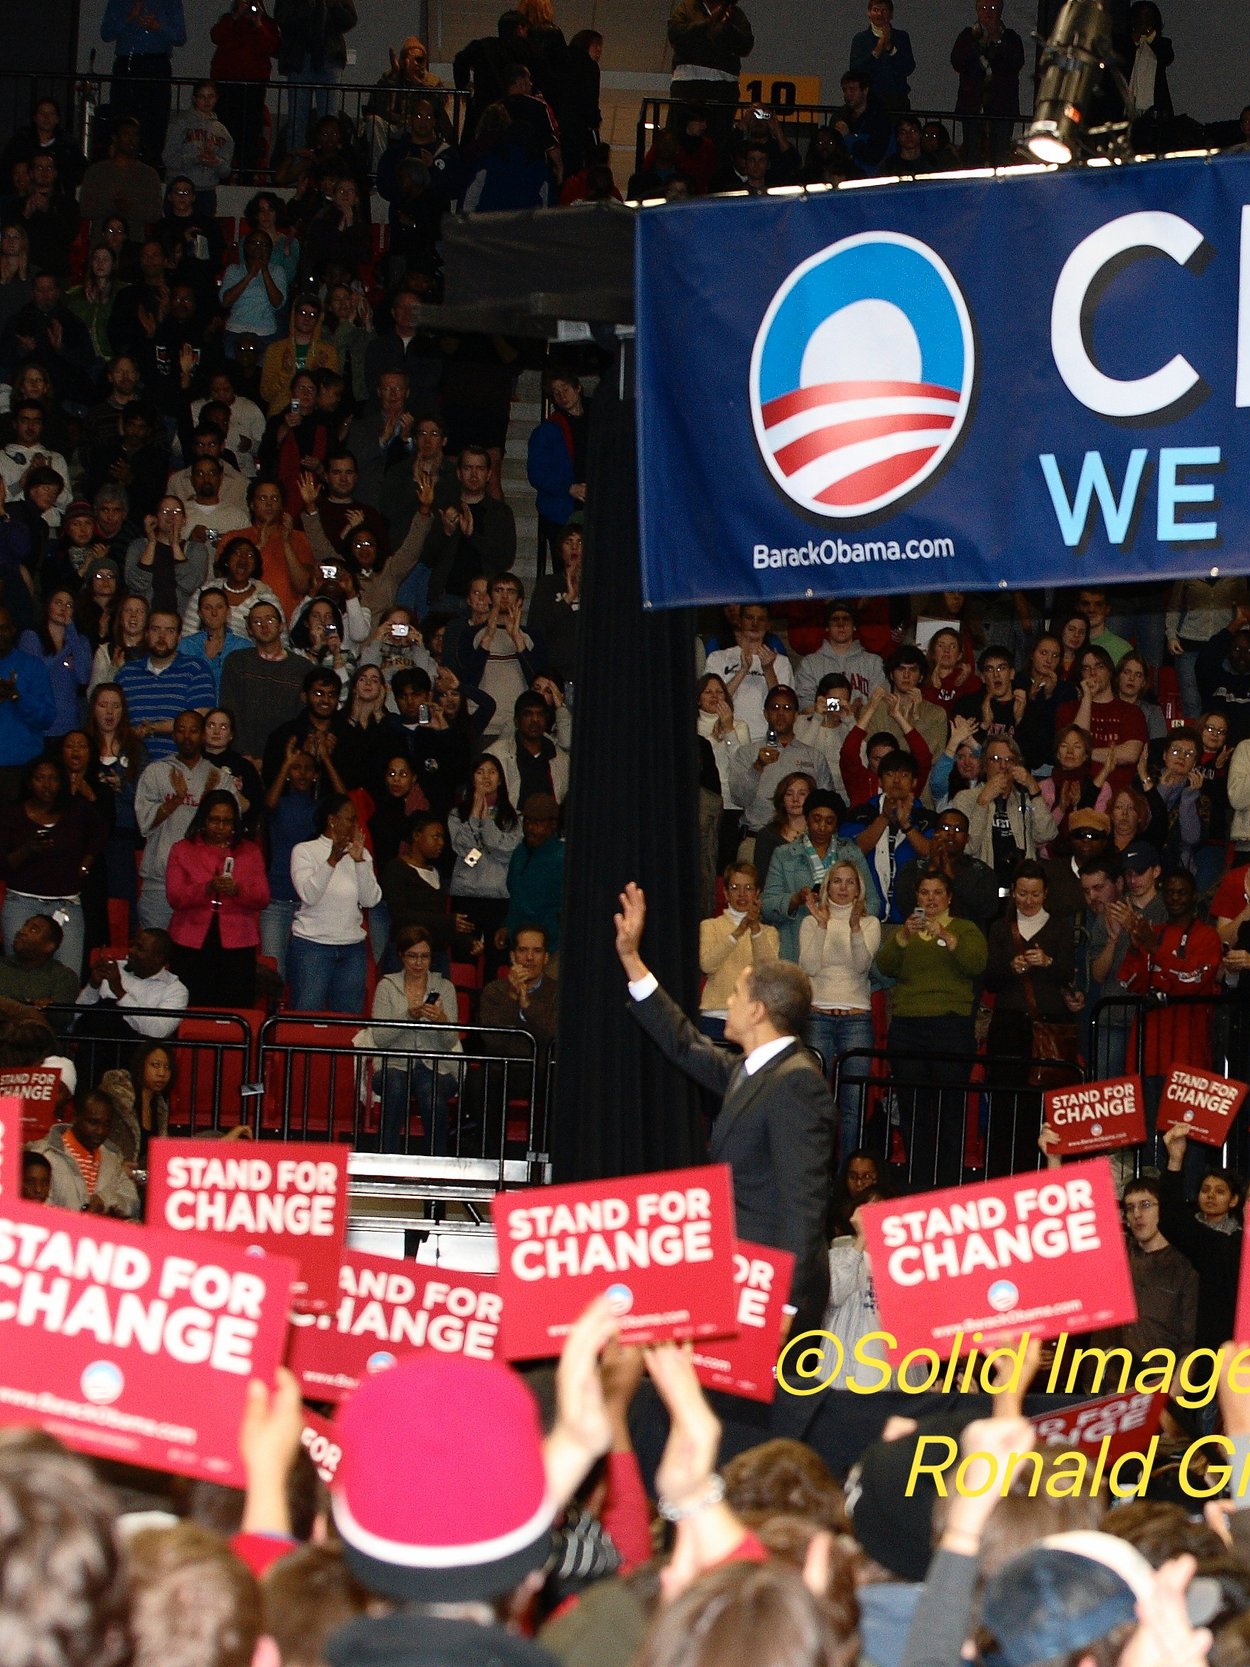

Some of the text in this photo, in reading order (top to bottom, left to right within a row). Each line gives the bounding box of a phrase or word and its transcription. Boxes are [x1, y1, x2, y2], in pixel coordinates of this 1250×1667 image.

[746, 80, 797, 116] 10
[1039, 447, 1222, 547] WE
[753, 536, 955, 571] BarackObama.com
[31, 1073, 56, 1086] FOR
[1051, 1083, 1135, 1110] STAND FOR
[1171, 1070, 1239, 1101] STAND FOR
[1053, 1097, 1136, 1126] CHANGE
[1167, 1084, 1233, 1116] CHANGE
[167, 1157, 338, 1194] STAND FOR
[165, 1188, 337, 1236] CHANGE
[508, 1186, 712, 1242] STAND FOR
[880, 1178, 1095, 1247] STAND FOR
[510, 1220, 714, 1282] CHANGE
[888, 1209, 1101, 1287] CHANGE
[159, 1255, 266, 1319] FOR
[732, 1253, 775, 1291] OR
[338, 1265, 416, 1304] AND
[423, 1281, 503, 1324] FOR
[289, 1296, 500, 1361] HANGE
[1045, 1407, 1148, 1446] NGE
[1077, 1393, 1155, 1426] FOR
[301, 1426, 342, 1472] FOR
